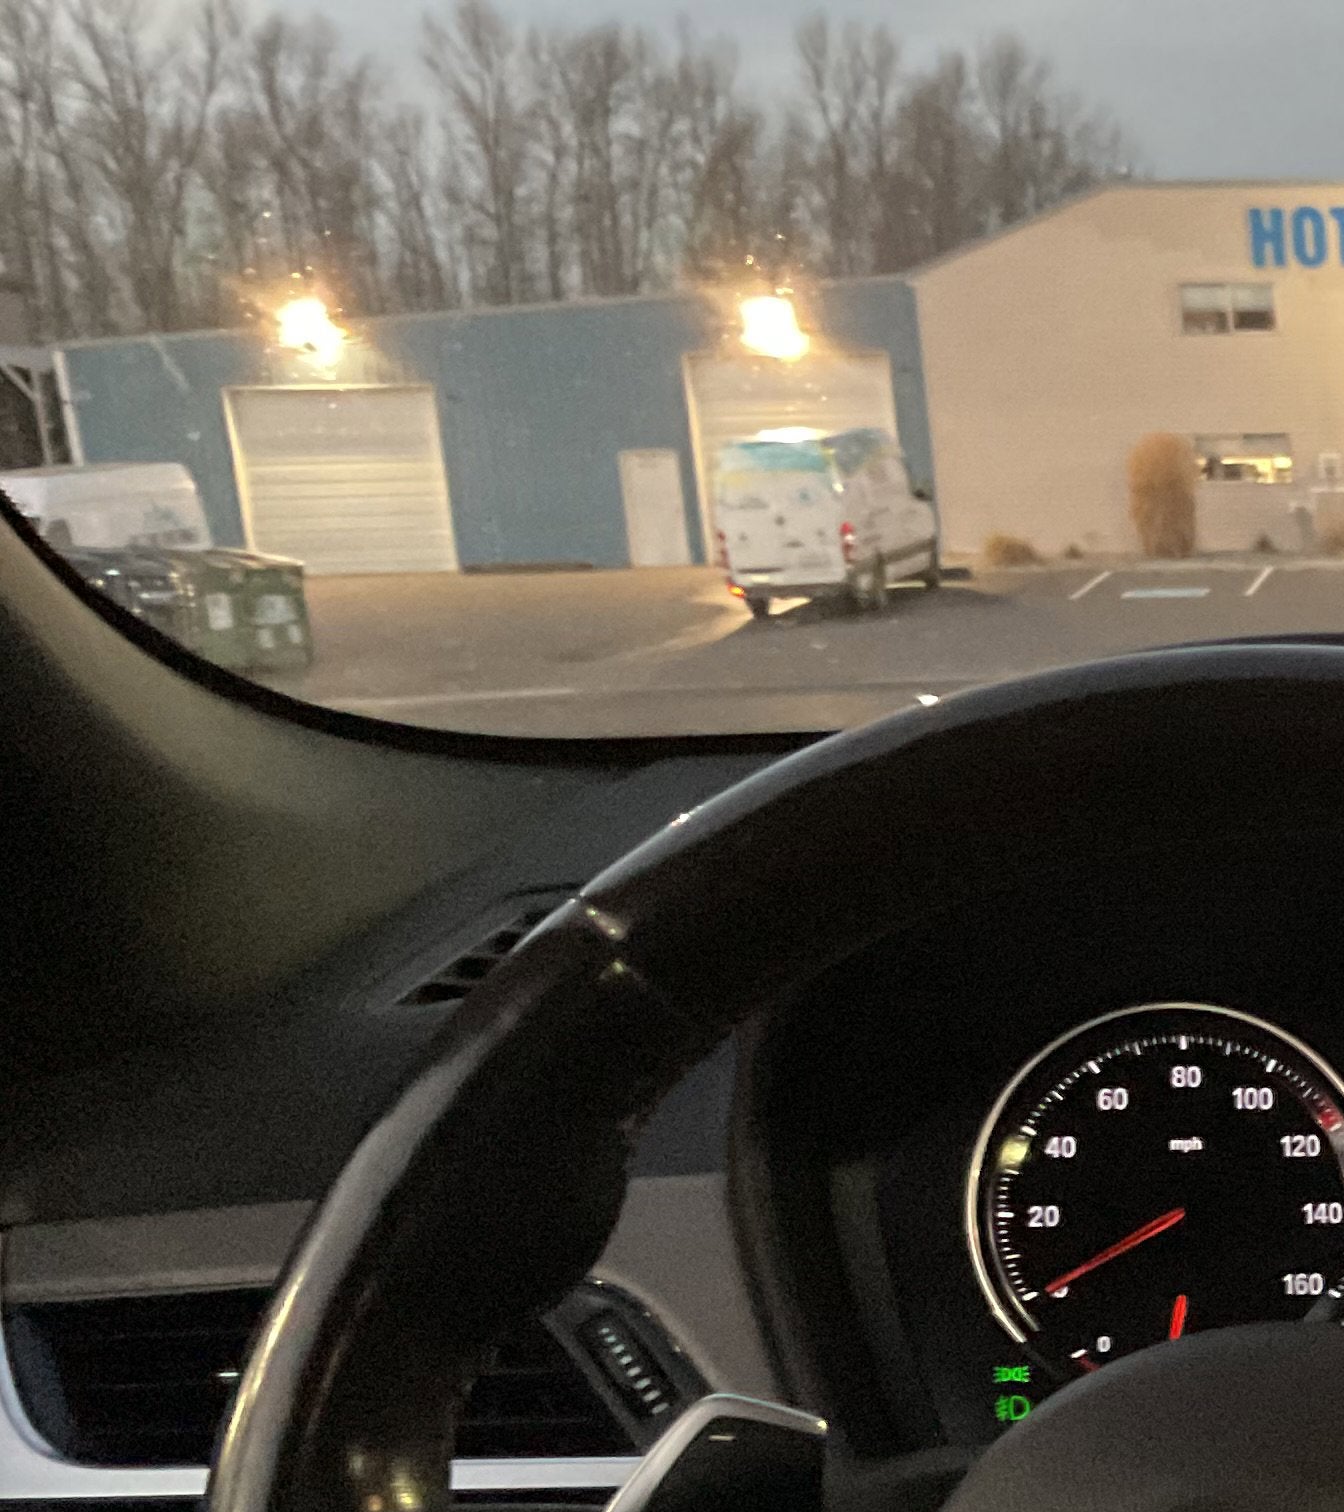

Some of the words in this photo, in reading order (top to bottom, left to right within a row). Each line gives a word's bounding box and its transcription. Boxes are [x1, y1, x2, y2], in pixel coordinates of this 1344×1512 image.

[1170, 1065, 1202, 1089] 80
[1096, 1087, 1129, 1111] 60
[1232, 1087, 1274, 1111] 100
[1044, 1135, 1077, 1158] 40
[1168, 1137, 1204, 1153] mph
[1280, 1135, 1321, 1158] 120
[1026, 1205, 1061, 1228] 20
[1302, 1201, 1343, 1225] 140
[1283, 1272, 1324, 1296] 160
[1096, 1335, 1112, 1354] 0
